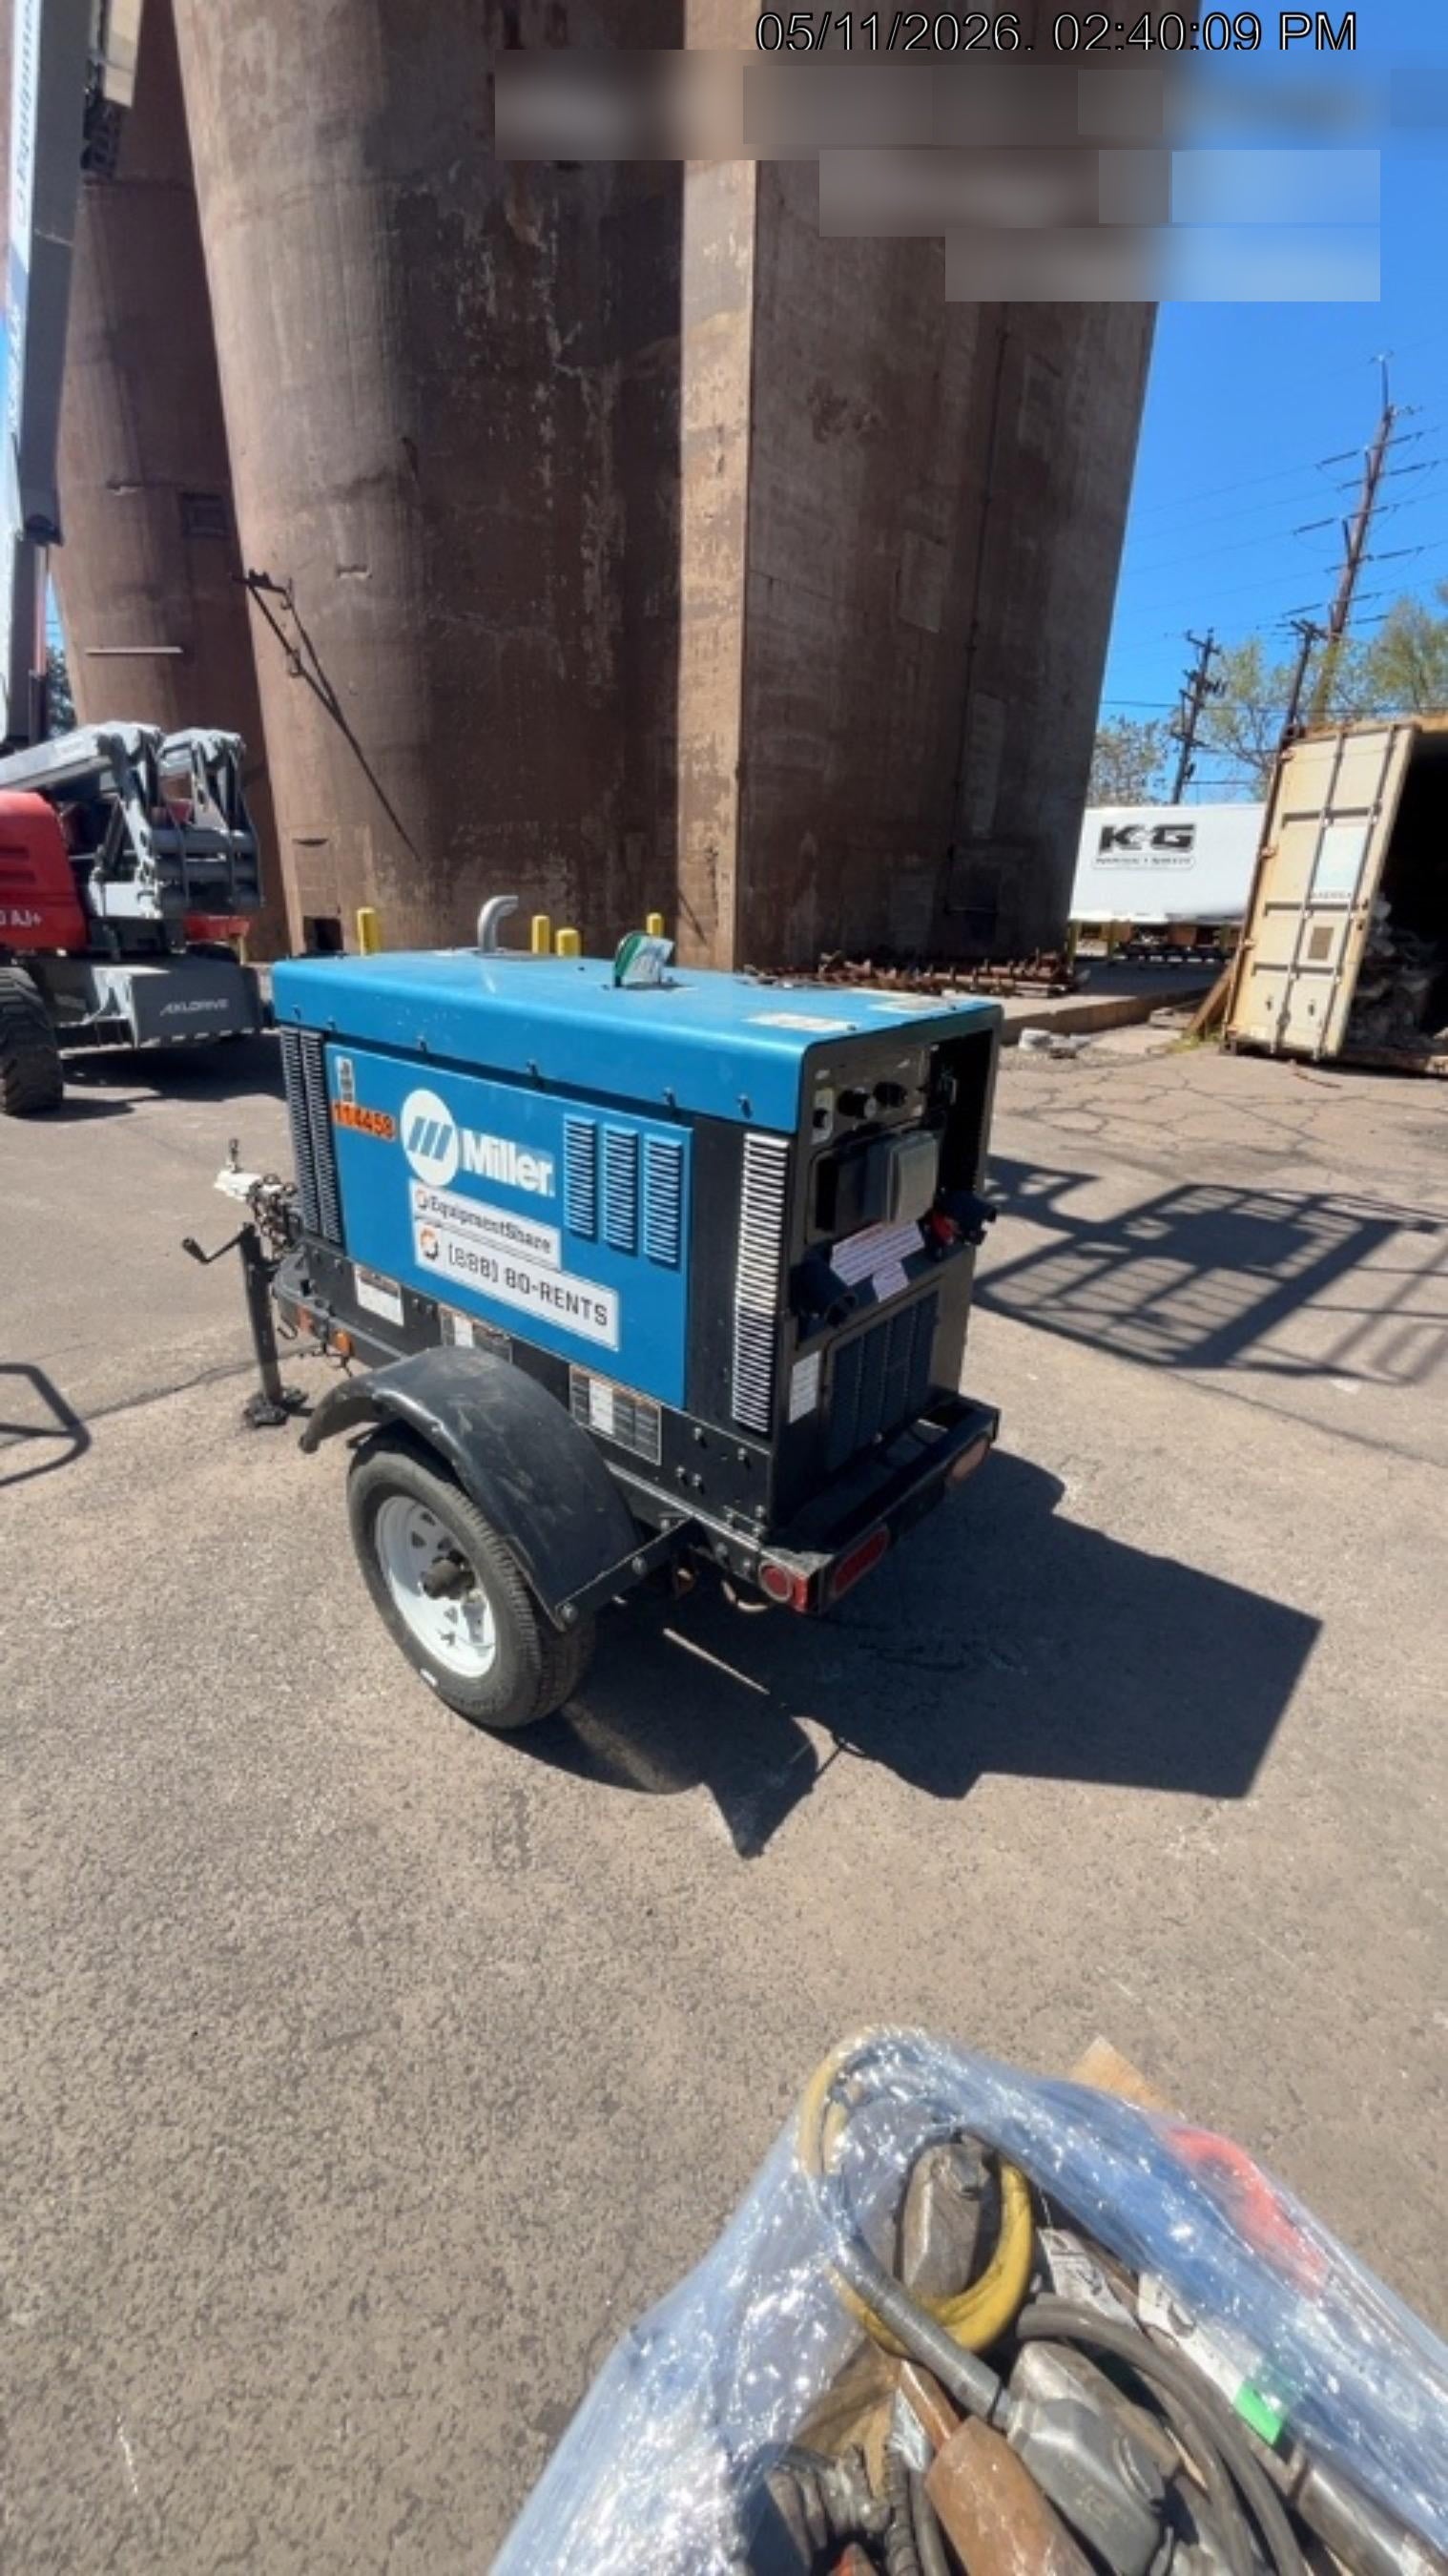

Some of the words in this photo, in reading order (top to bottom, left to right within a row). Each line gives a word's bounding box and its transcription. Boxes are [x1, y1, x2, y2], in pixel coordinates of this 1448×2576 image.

[428, 1195, 552, 1255] EquipmentShare
[448, 1242, 500, 1284] (888)
[505, 1267, 609, 1327] 80-RENTS
